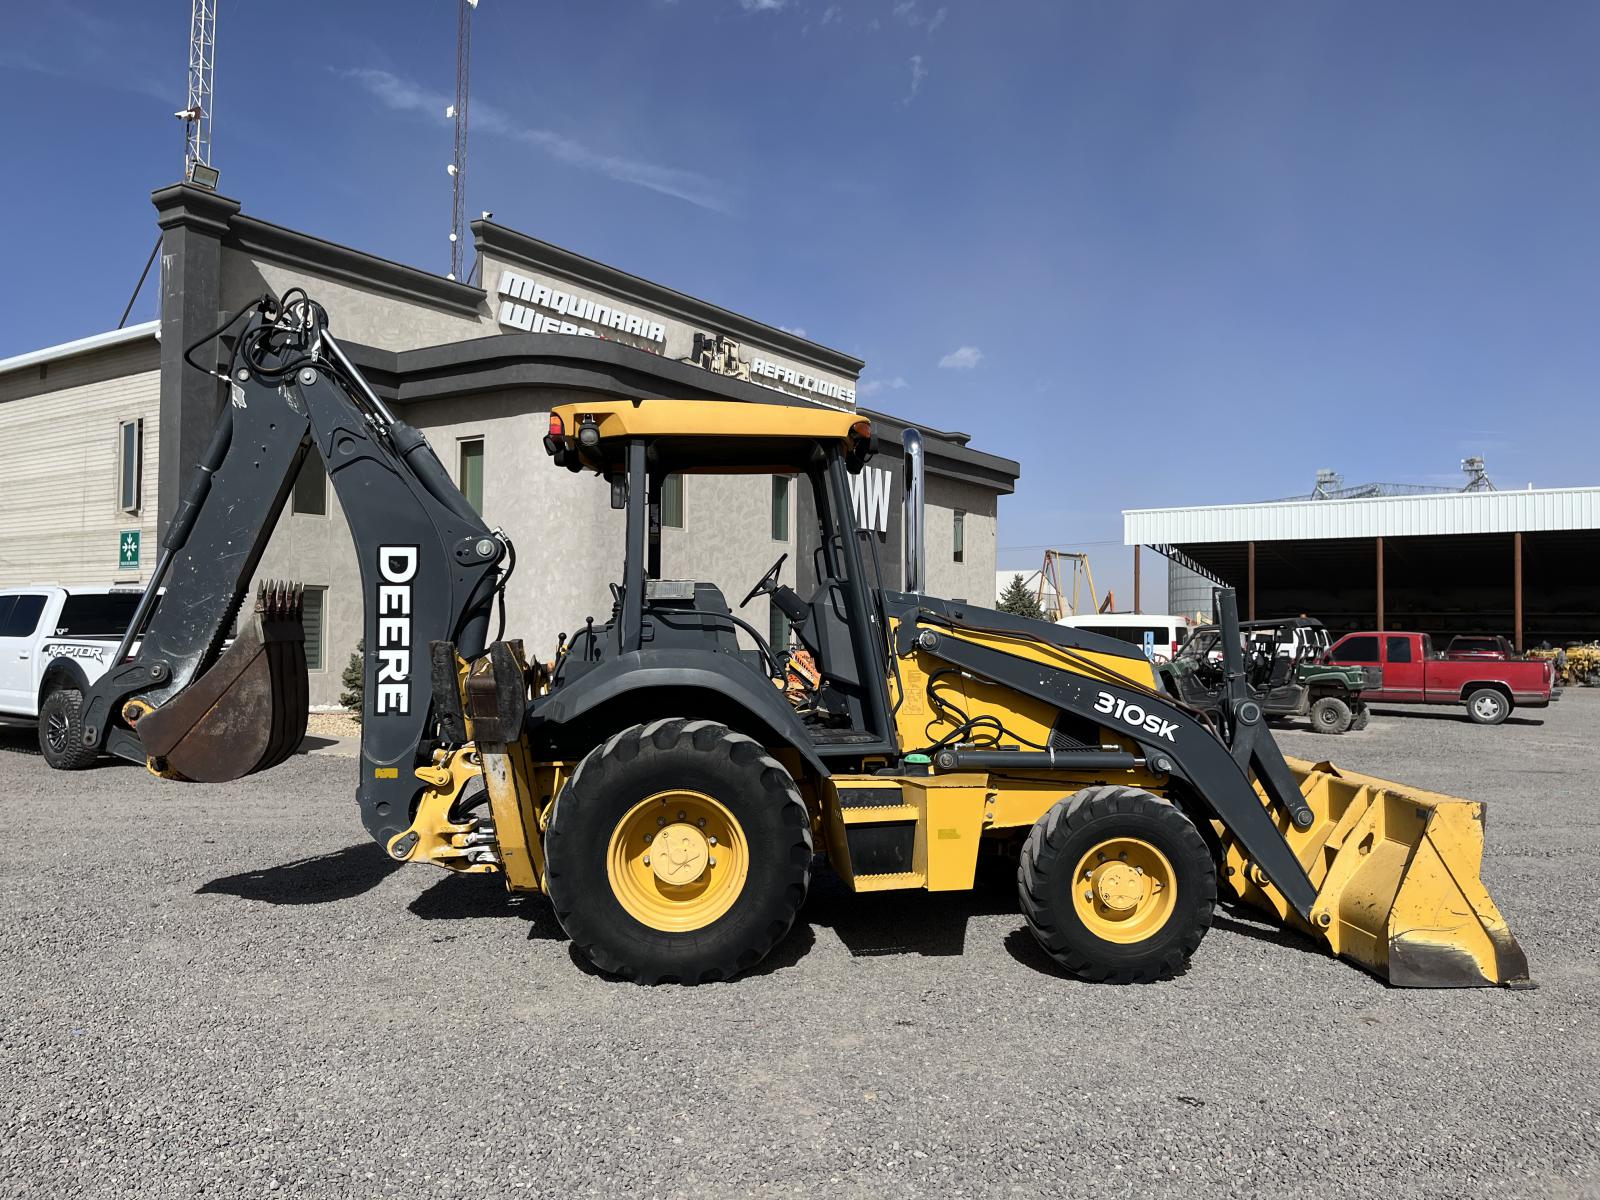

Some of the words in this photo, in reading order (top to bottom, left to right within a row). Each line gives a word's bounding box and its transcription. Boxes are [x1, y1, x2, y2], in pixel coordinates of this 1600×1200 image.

[498, 271, 665, 342] MAQUINARIA
[752, 357, 856, 404] REFACCIONES
[48, 644, 104, 664] RAPTOR
[377, 546, 418, 714] DEERE
[1093, 691, 1180, 742] 310SK
